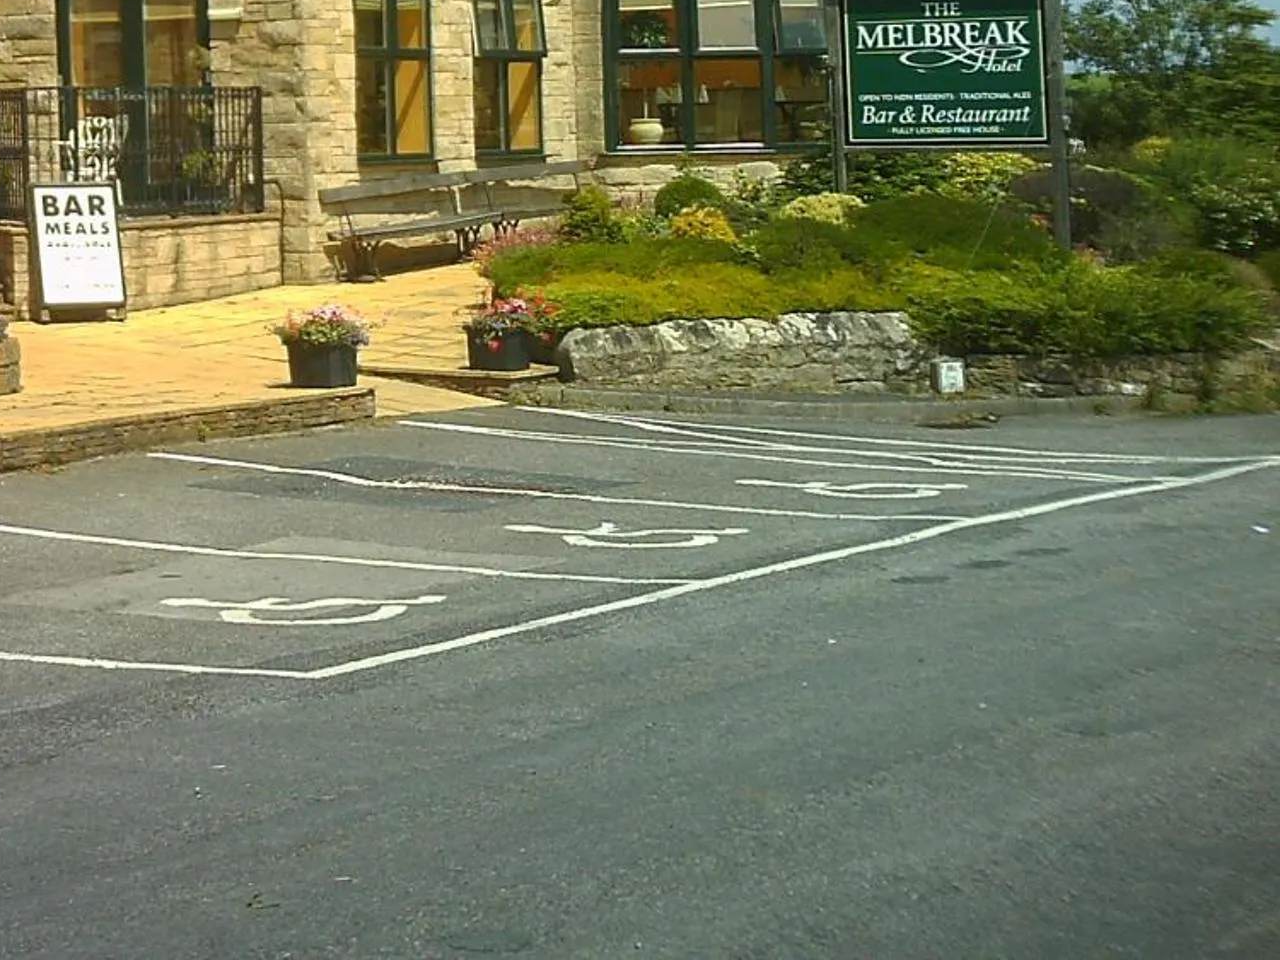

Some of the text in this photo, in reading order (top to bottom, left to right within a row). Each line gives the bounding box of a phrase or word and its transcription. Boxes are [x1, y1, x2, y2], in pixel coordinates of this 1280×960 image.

[921, 2, 961, 17] THE
[856, 20, 1031, 50] MELBREAK
[962, 48, 1022, 73] Hotel
[862, 104, 1031, 125] Bar & Restaurant
[42, 194, 106, 217] BAR
[45, 221, 110, 235] MEALS
